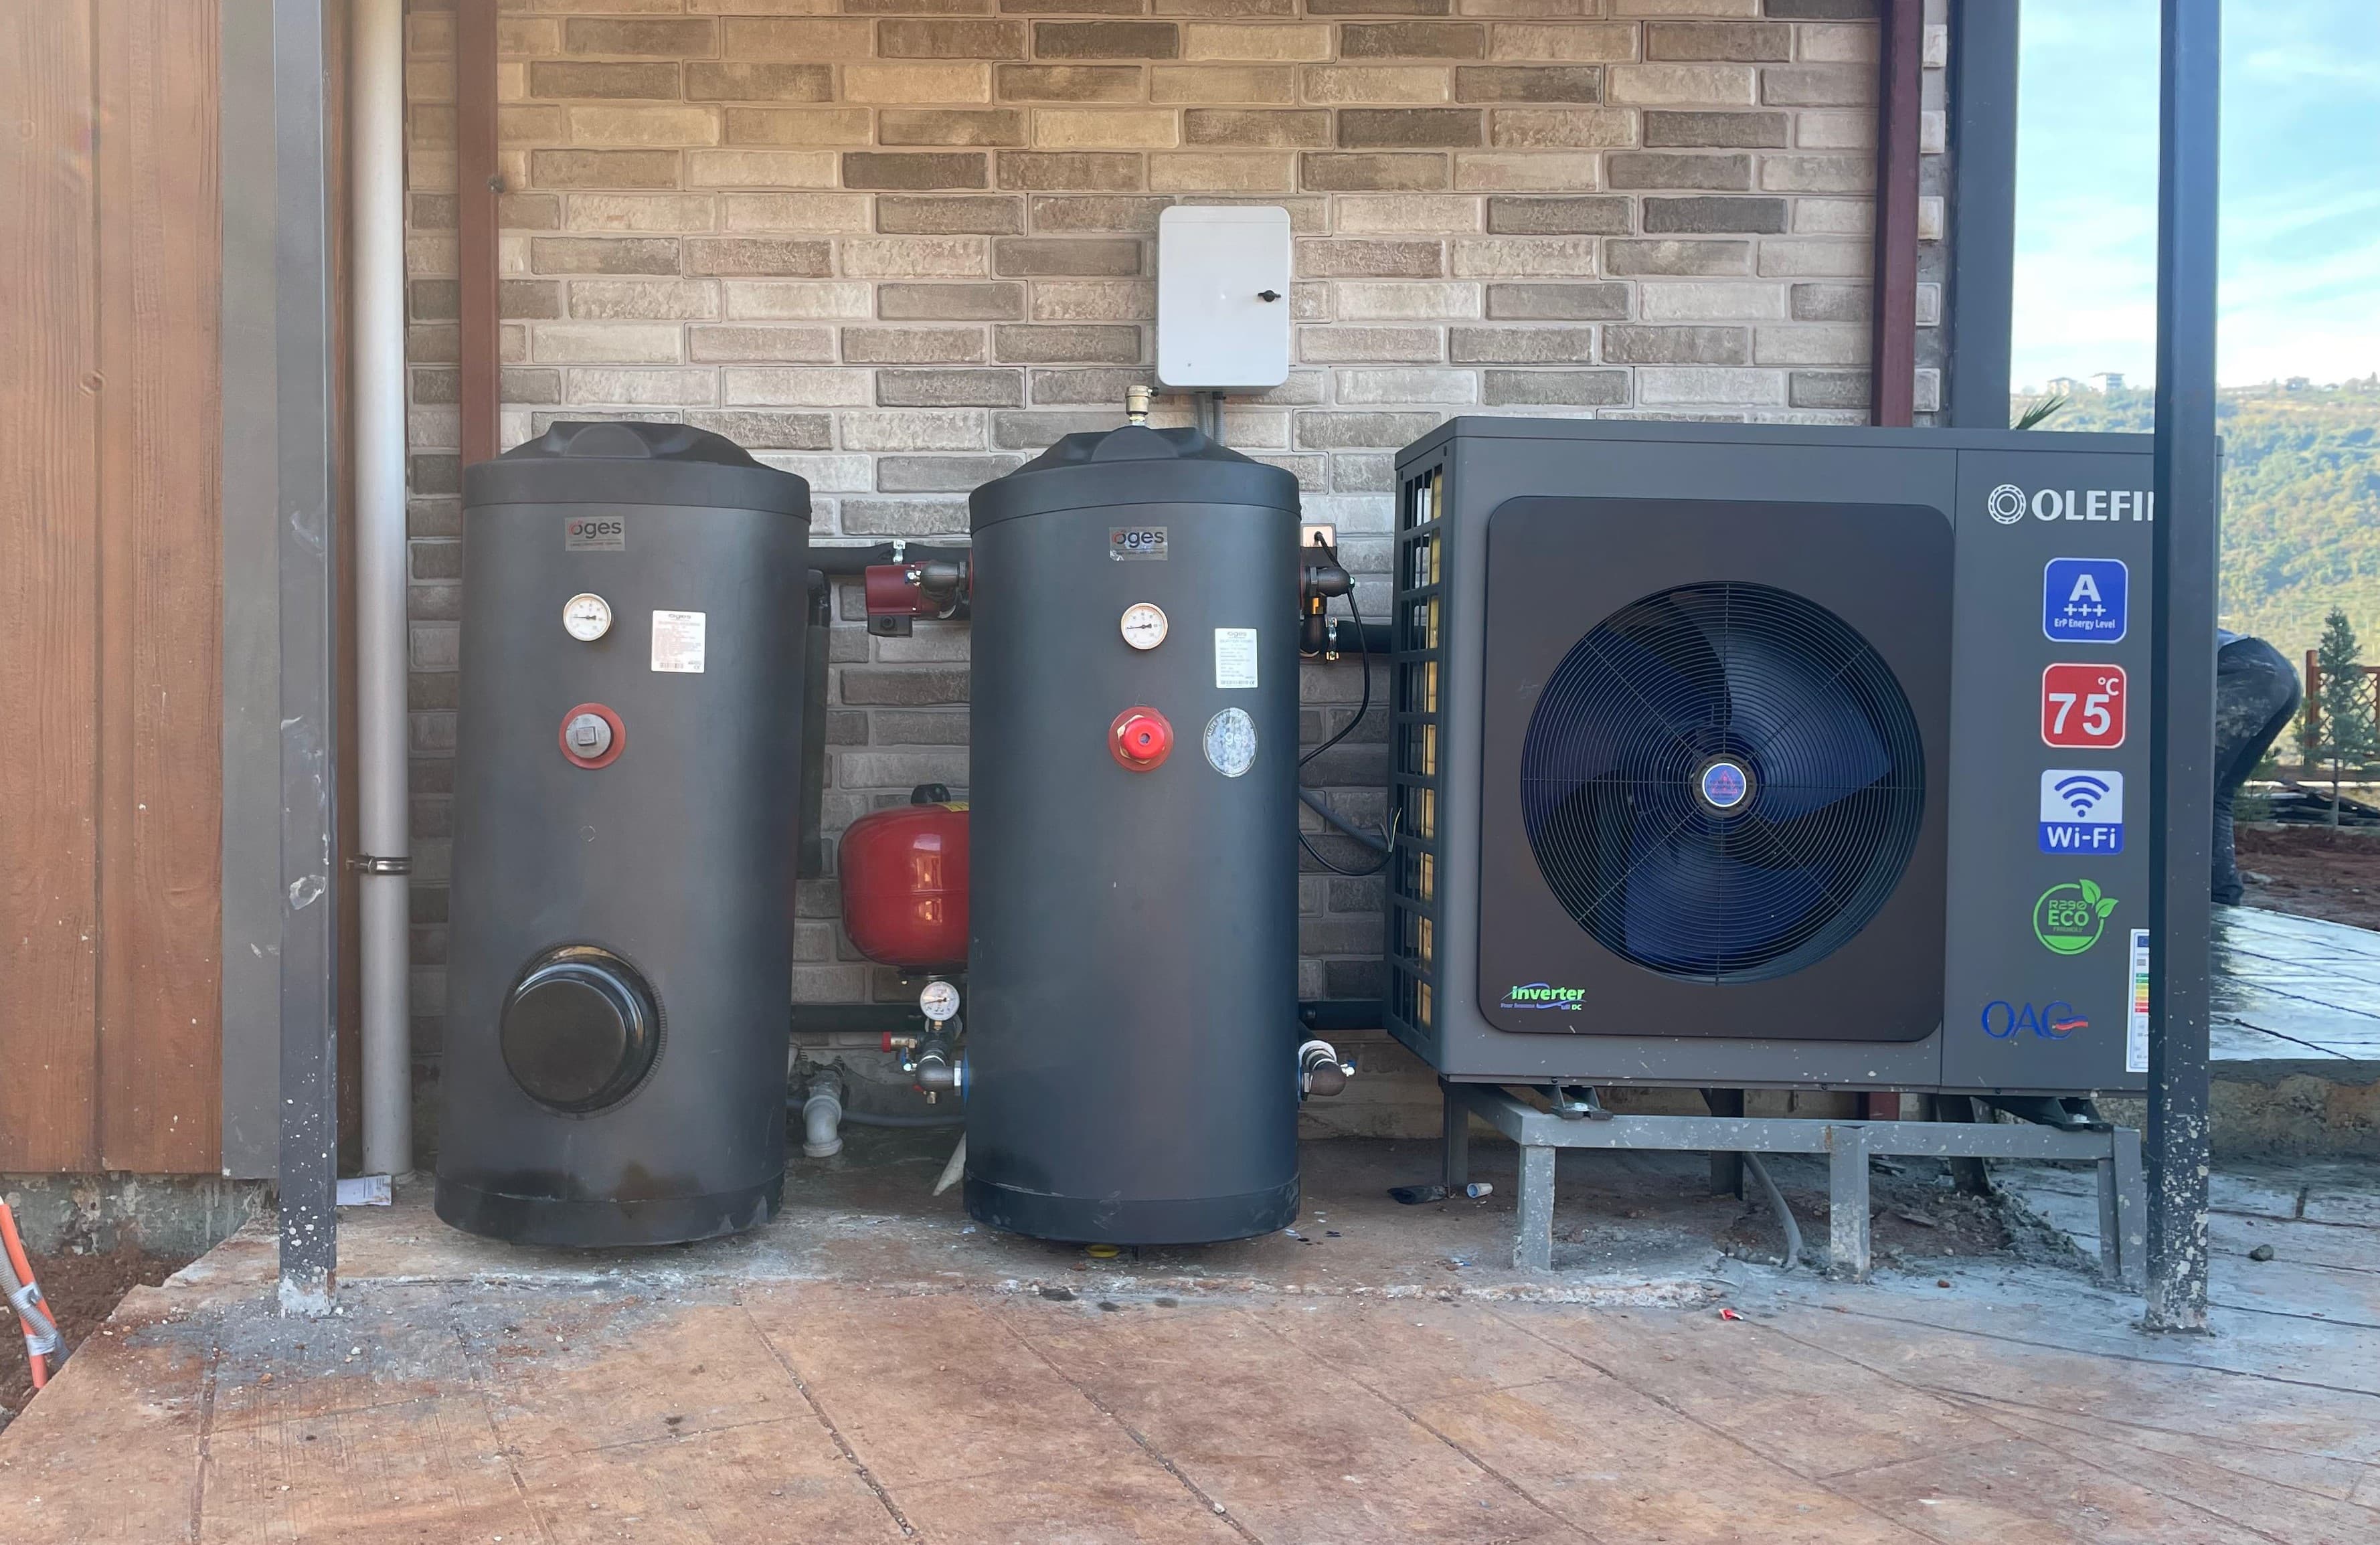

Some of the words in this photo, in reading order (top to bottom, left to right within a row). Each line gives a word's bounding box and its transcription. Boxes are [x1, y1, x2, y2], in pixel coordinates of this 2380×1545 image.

[2031, 488, 2154, 521] OLEFI
[2054, 618, 2068, 628] ErP
[2069, 618, 2095, 630] Energy
[2096, 619, 2116, 629] Level
[2046, 826, 2116, 850] Wi-Fi
[2049, 899, 2088, 910] R290
[2048, 910, 2090, 927] ECO
